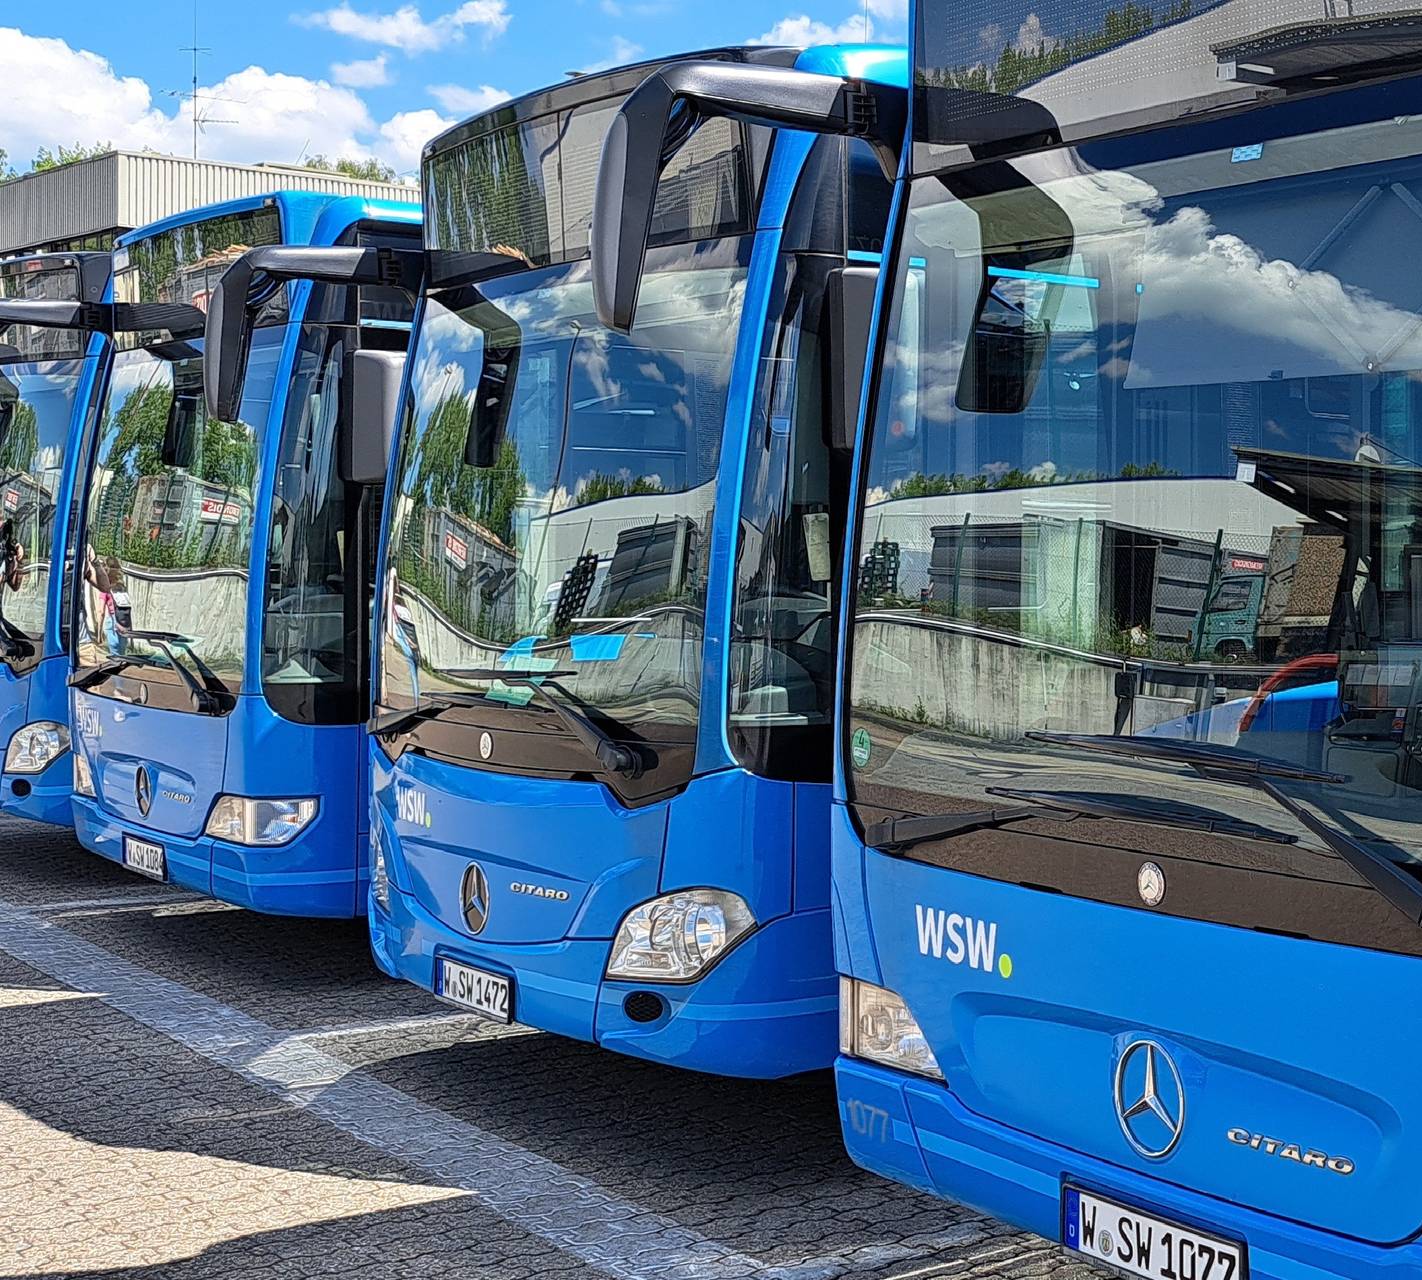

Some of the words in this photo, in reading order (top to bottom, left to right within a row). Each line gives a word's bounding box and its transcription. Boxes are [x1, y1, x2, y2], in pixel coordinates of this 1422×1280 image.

[162, 790, 191, 804] CITARO
[510, 881, 570, 901] CITARO
[476, 977, 508, 1014] 1472
[847, 1098, 889, 1143] 1077
[1227, 1127, 1354, 1175] CITARO
[1081, 1201, 1097, 1250] W
[1117, 1216, 1153, 1272] SW
[1160, 1232, 1236, 1280] 1077
